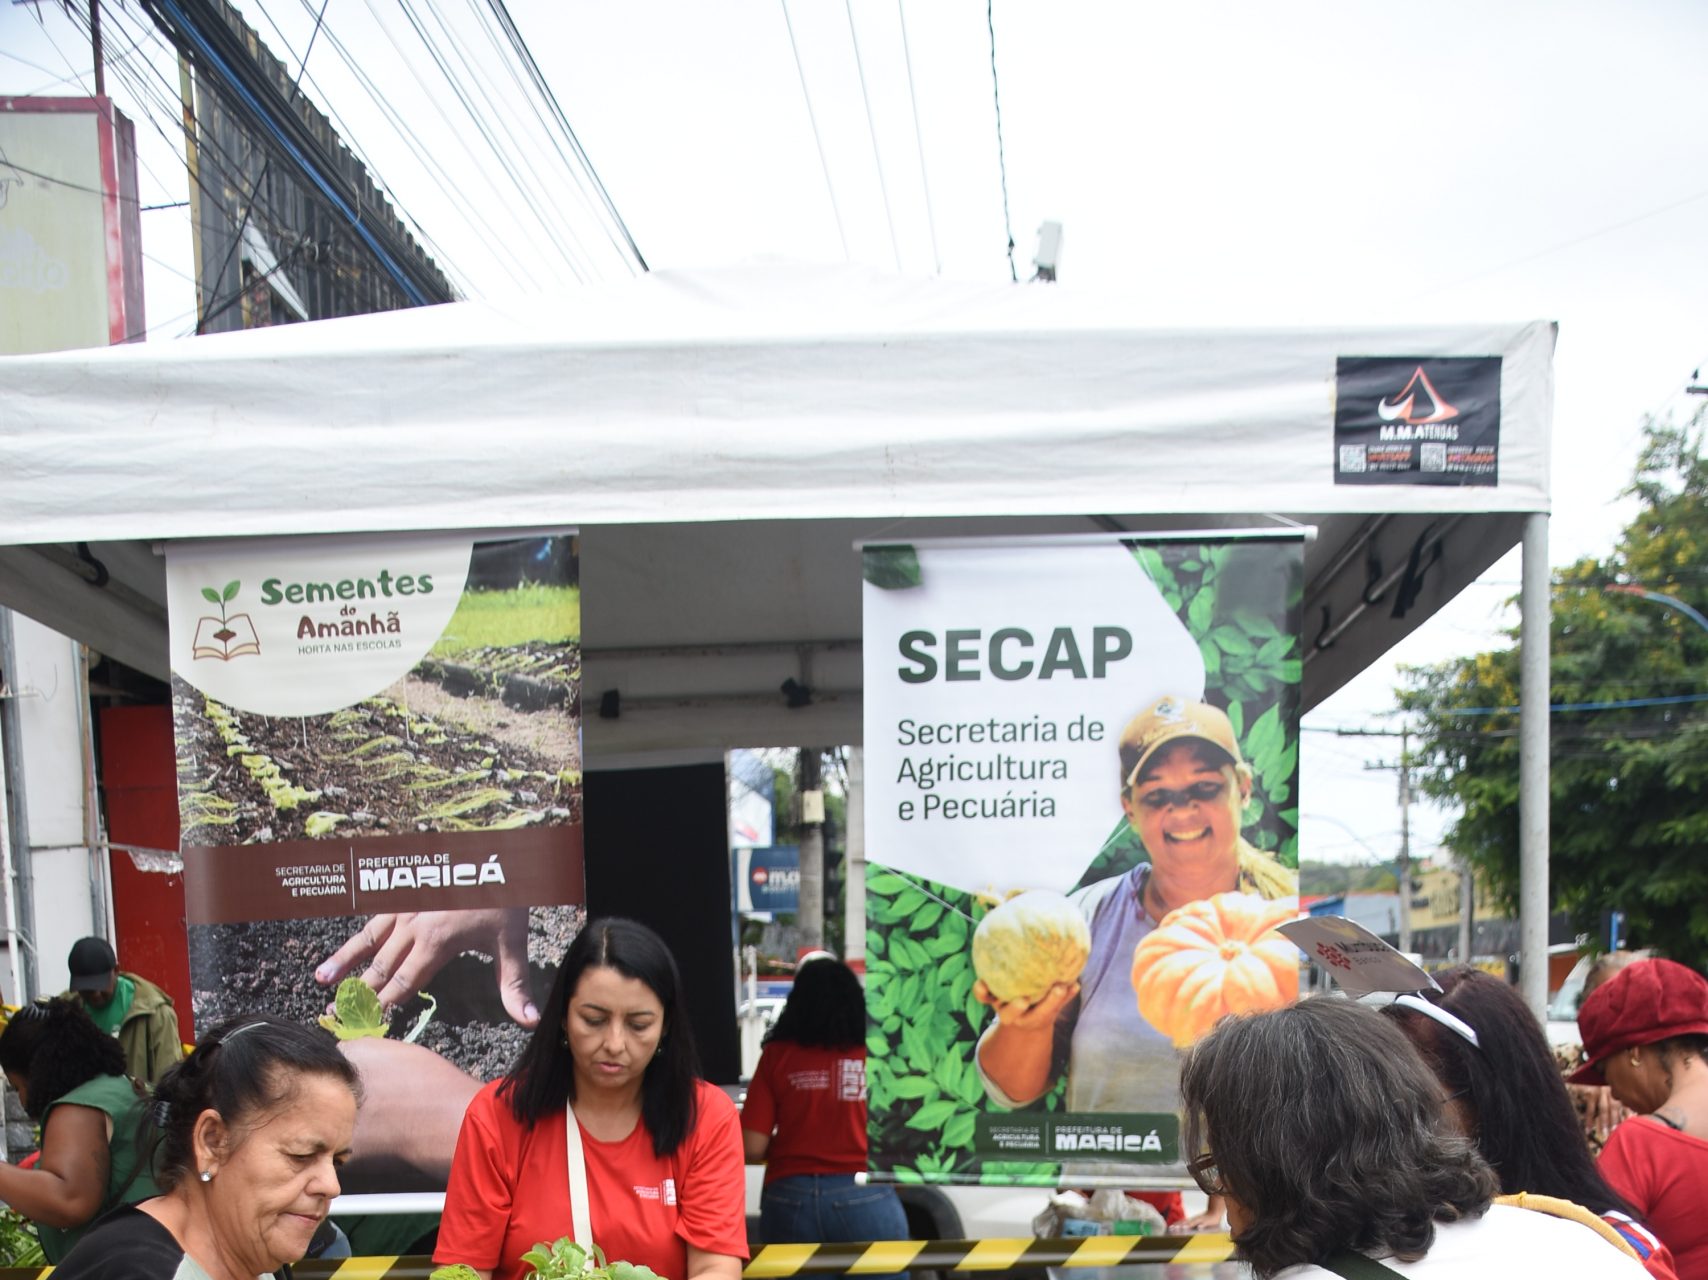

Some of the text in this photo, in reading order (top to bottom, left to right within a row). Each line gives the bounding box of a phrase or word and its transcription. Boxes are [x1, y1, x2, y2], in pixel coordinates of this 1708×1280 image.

[261, 569, 434, 605] Sementes
[340, 604, 357, 616] do
[297, 611, 401, 639] Amanhã
[298, 639, 402, 655] HORTA NAS ESCOLAS
[897, 626, 1133, 684] SECAP
[897, 714, 1105, 746] Secretaria de
[896, 753, 1068, 789] Agricultura
[899, 791, 1056, 821] e Pecuária
[275, 863, 345, 877] SECRETARIA DE
[358, 853, 450, 868] PREFEITURA DE
[282, 874, 346, 887] AGRICULTURA
[359, 854, 506, 892] MARICÁ
[292, 884, 347, 897] E PECUÁRIA
[1055, 1126, 1123, 1134] PREFEITURA DE
[1055, 1129, 1162, 1151] MARICÁ
